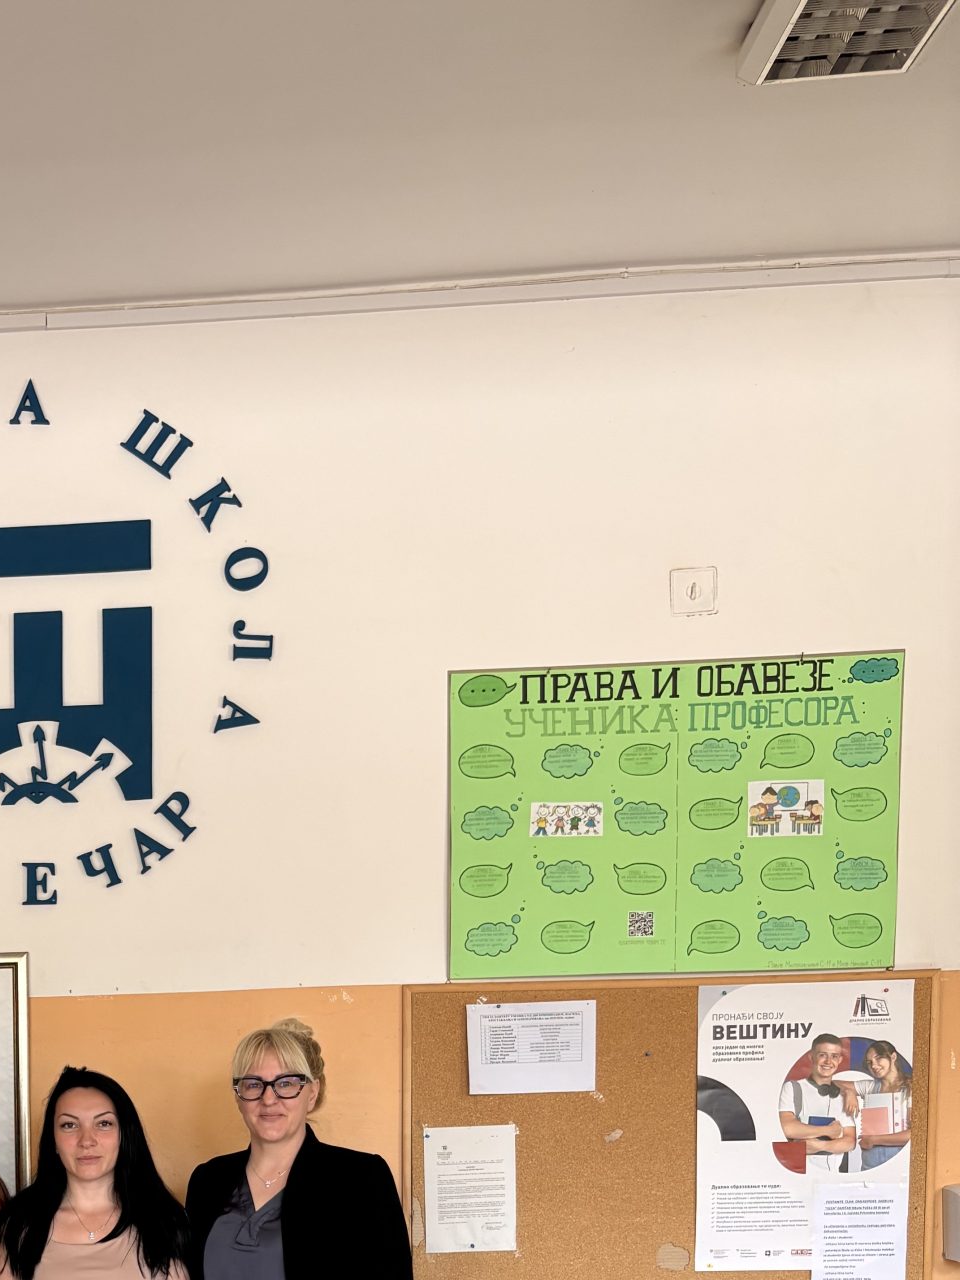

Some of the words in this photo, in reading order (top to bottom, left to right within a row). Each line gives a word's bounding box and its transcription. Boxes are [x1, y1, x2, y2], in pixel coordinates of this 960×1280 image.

[120, 409, 274, 734] ШКОЛА
[519, 671, 642, 705] ПРАВА
[651, 667, 681, 699] И
[697, 658, 835, 697] ОБАВЕЗЕ
[711, 1012, 755, 1021] ПРОНАЂИ
[756, 1012, 784, 1020] СВОЈУ
[712, 1022, 813, 1041] ВЕШТИНУ
